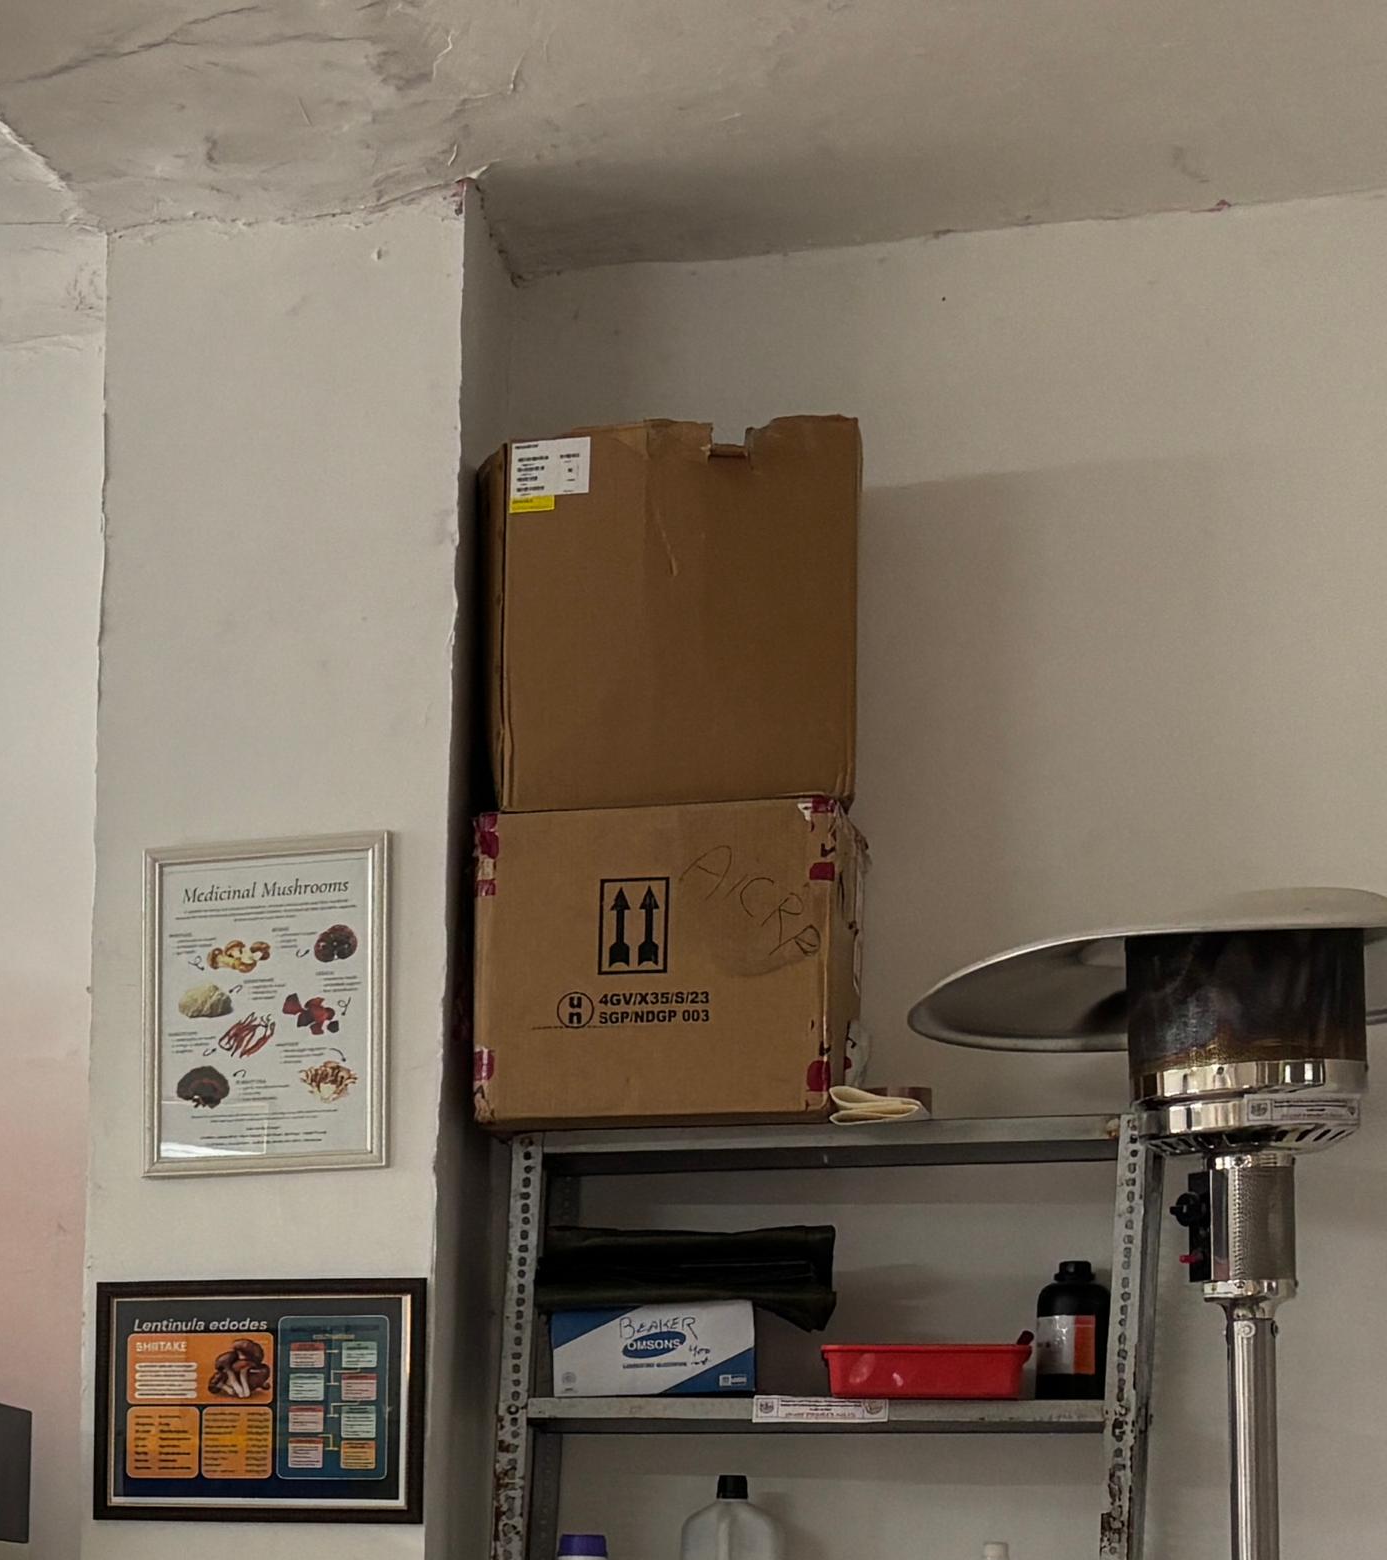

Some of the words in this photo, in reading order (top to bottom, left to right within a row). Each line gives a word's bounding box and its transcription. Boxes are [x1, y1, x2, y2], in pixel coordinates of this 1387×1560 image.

[183, 881, 257, 904] Medicinal
[261, 878, 349, 898] Mushrooms
[599, 991, 709, 1006] 4GV/X35/S/23
[599, 1010, 677, 1024] SGP/NDGP
[682, 1009, 710, 1022] 003
[134, 1318, 205, 1331] Lentinula
[209, 1317, 267, 1331] edodes
[619, 1316, 698, 1340] BEAKER
[627, 1338, 681, 1351] OMSONS
